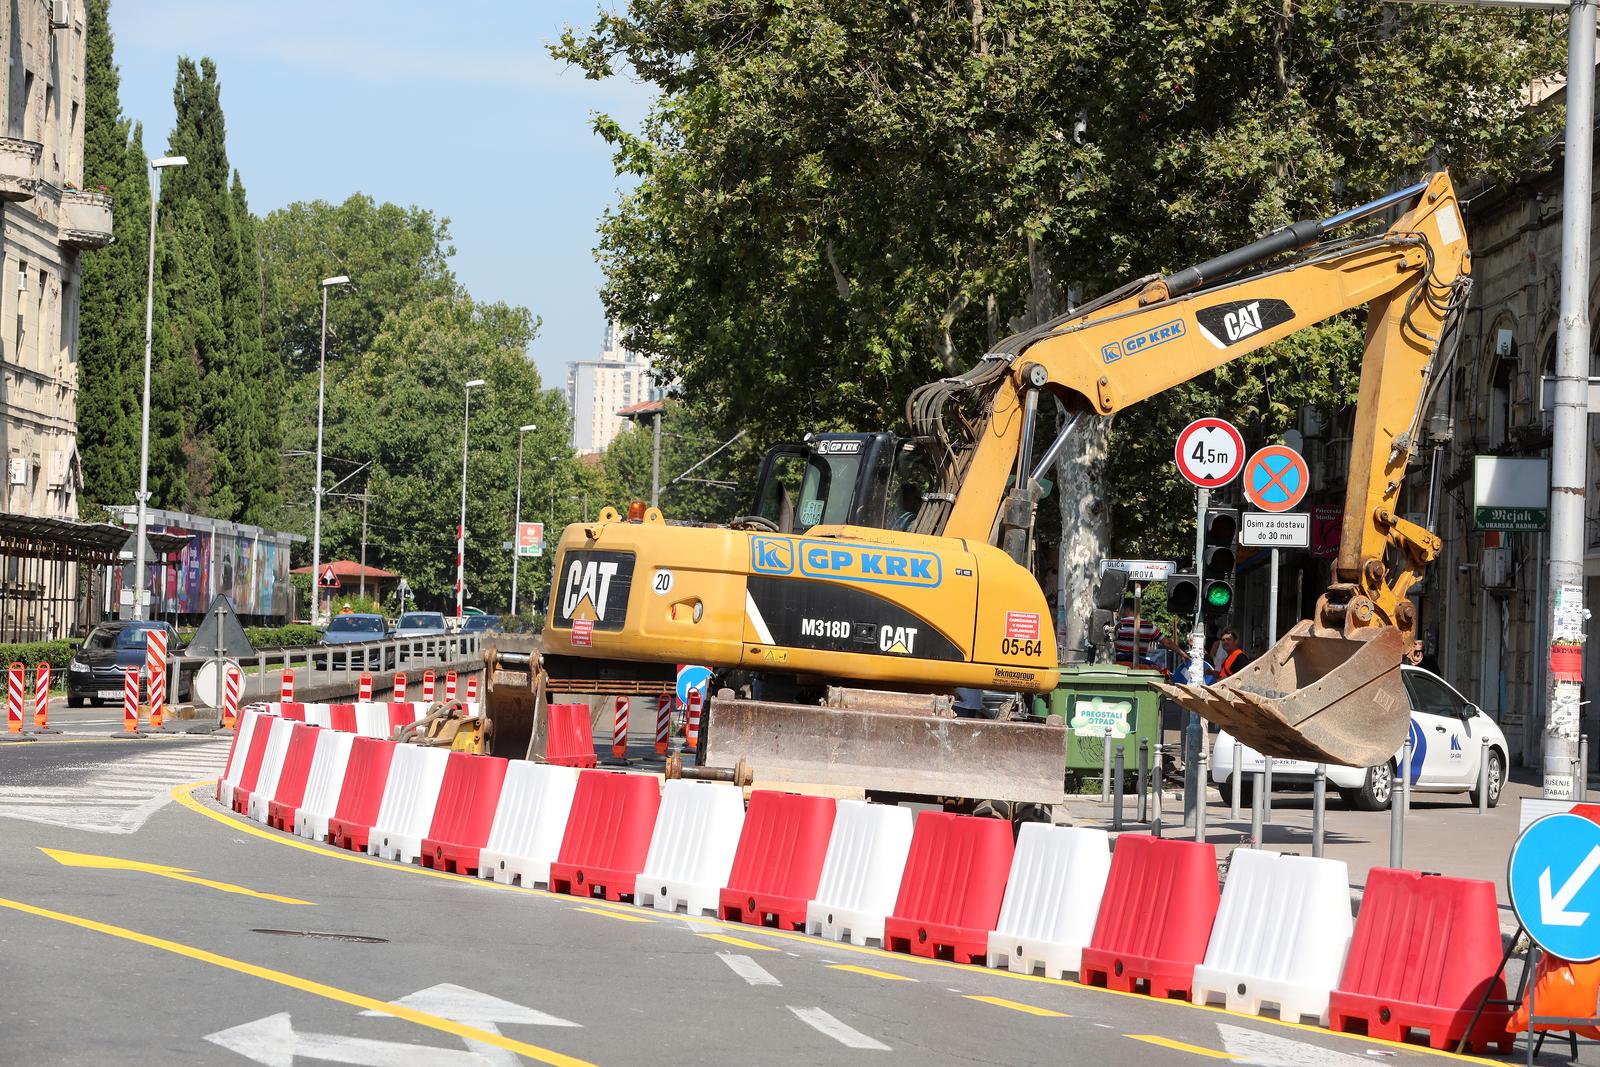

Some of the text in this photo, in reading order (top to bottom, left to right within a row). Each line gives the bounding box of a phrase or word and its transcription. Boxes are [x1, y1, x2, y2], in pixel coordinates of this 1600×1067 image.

[1223, 301, 1263, 341] CAT
[1127, 336, 1147, 351] GP
[1149, 323, 1181, 343] KRK
[831, 443, 841, 451] GP
[842, 443, 859, 451] KRK
[1246, 519, 1264, 528] Osim
[1276, 520, 1305, 529] dostavu
[1491, 510, 1531, 523] Mejak
[1257, 531, 1293, 540] do 30 min
[808, 547, 853, 571] GP
[861, 552, 932, 579] KRK
[1128, 570, 1154, 578] MIROVA
[655, 573, 670, 591] 20
[562, 560, 618, 621] CAT
[801, 618, 918, 654] M318D CAT
[1002, 638, 1042, 657] 05-64
[1081, 710, 1123, 719] PREOSTALI
[1088, 717, 1115, 726] OTPAD
